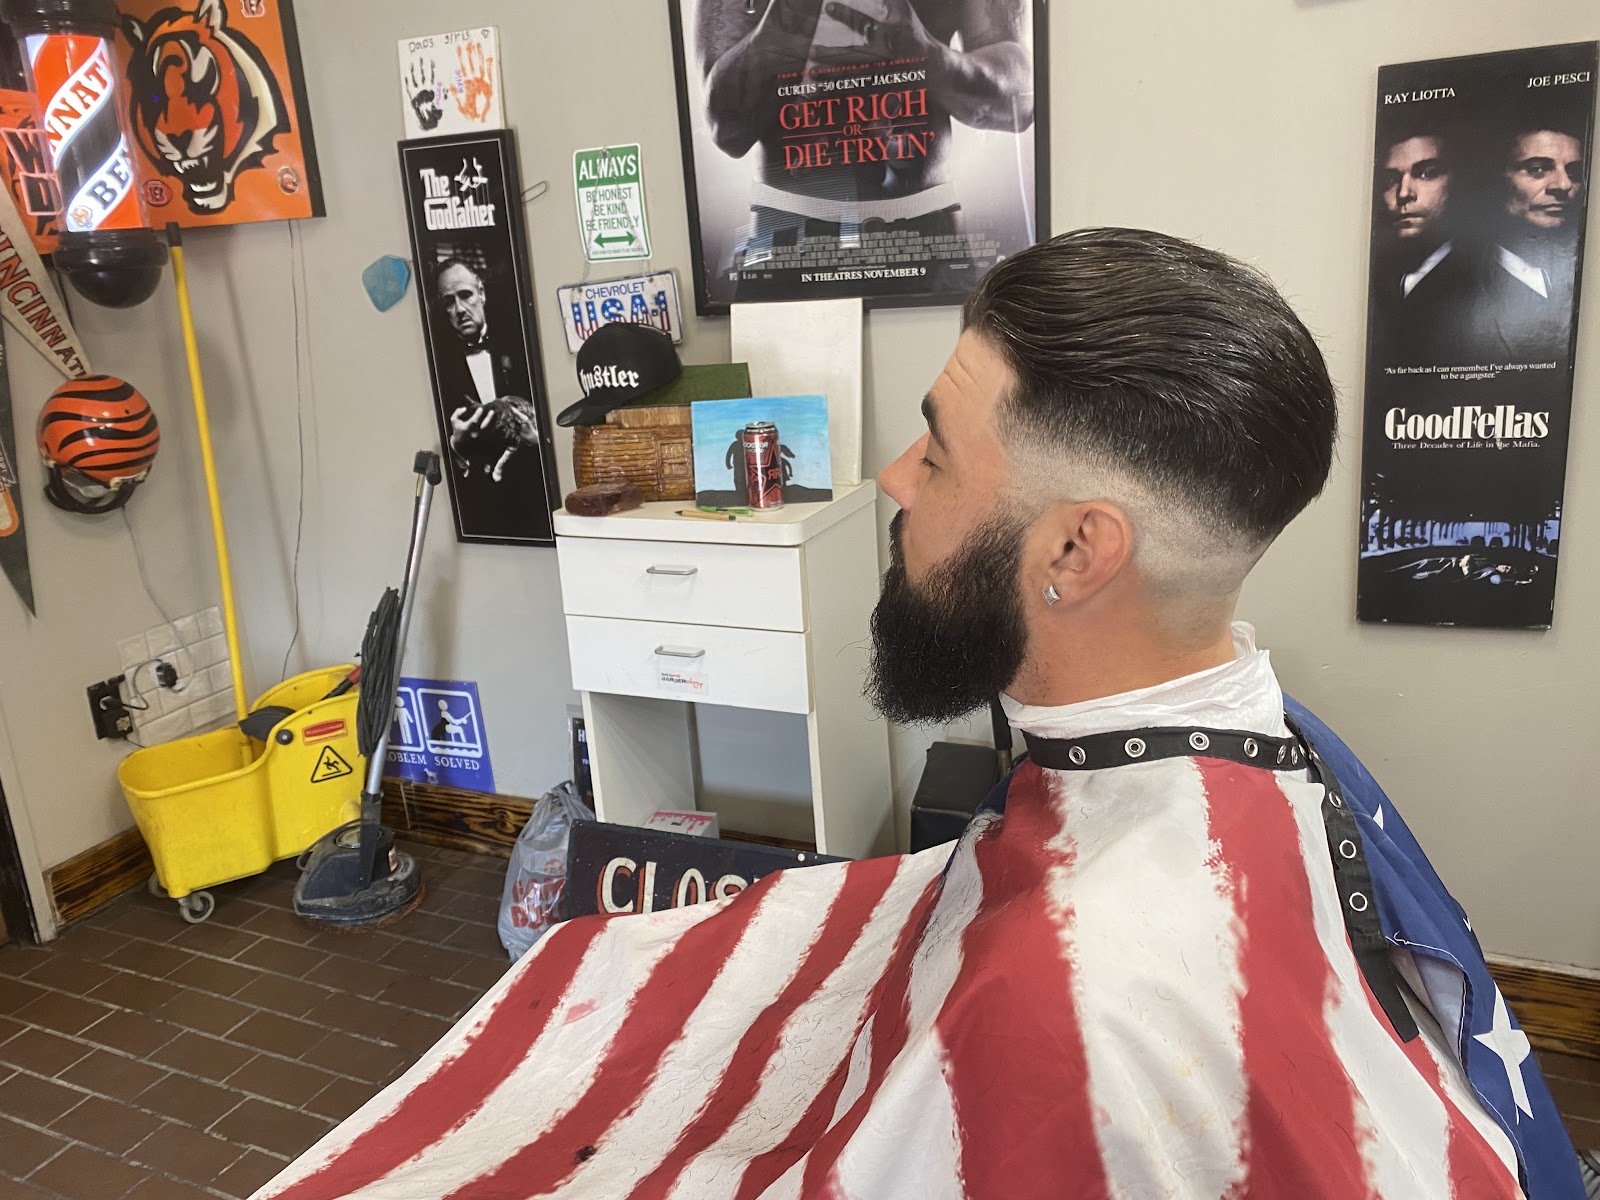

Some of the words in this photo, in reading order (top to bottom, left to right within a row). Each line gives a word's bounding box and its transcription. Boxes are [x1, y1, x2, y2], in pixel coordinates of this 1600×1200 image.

[777, 83, 817, 97] CURTIS
[871, 70, 926, 86] JACKSON
[1527, 75, 1551, 89] JOE
[1554, 71, 1591, 85] PESCI
[1384, 93, 1409, 105] RAY
[1411, 87, 1456, 102] LIOTTA
[779, 98, 841, 130] GET
[847, 88, 929, 124] RICH
[842, 124, 863, 137] OR
[783, 141, 832, 170] DIE
[835, 131, 936, 165] TRYIN'
[579, 154, 637, 181] ALWAYS
[419, 168, 451, 198] The
[586, 191, 597, 203] BE
[599, 187, 632, 202] HONEST
[423, 195, 496, 231] Godfather
[594, 205, 606, 217] BE
[607, 202, 628, 216] KIND
[586, 220, 598, 231] BE
[598, 215, 639, 231] FRIENDLY
[801, 273, 813, 282] IN
[813, 271, 863, 281] THEATRES
[864, 268, 919, 279] NOVEMBER
[920, 267, 926, 276] 9
[585, 281, 646, 300] CHEVROLET
[1397, 366, 1407, 374] far
[1407, 366, 1424, 374] back
[1432, 365, 1436, 373] I
[1489, 363, 1503, 371] I've
[1504, 363, 1528, 372] always
[1528, 361, 1557, 370] wanted
[1449, 372, 1459, 380] be
[579, 364, 639, 397] hustler
[1385, 405, 1550, 441] GoodFellas
[1419, 441, 1453, 449] Decades
[1456, 441, 1466, 449] of
[1466, 441, 1483, 449] Life
[1512, 440, 1541, 448] Mafia.
[386, 751, 427, 765] OBLEM
[434, 756, 480, 770] SOLVED
